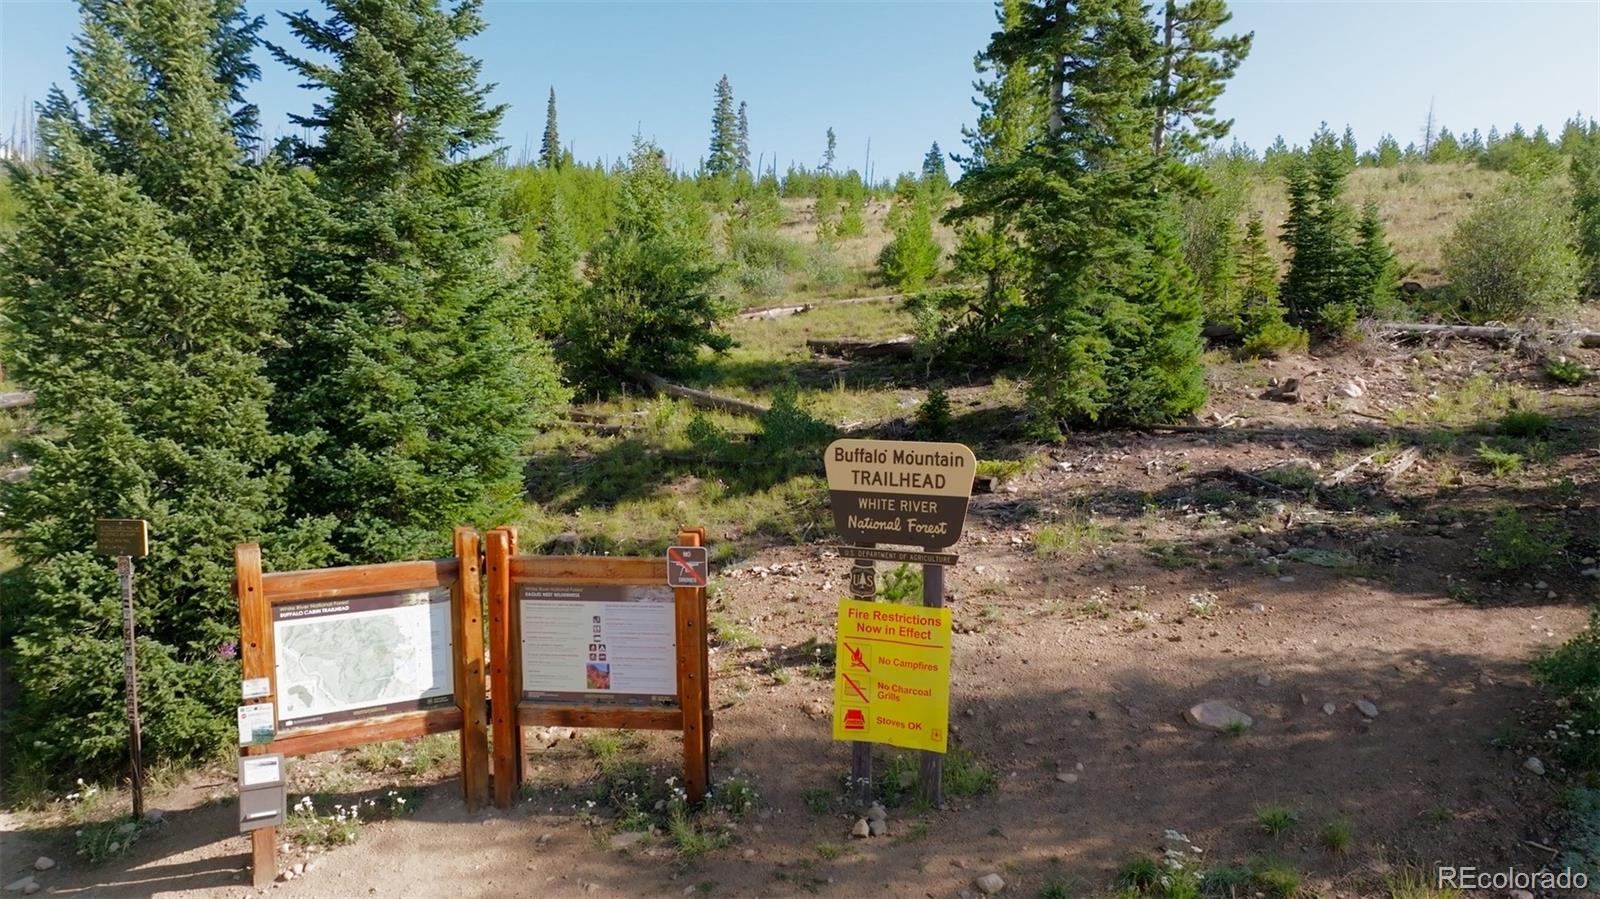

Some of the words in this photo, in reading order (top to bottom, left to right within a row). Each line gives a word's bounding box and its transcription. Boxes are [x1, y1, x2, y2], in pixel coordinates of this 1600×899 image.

[834, 447, 888, 464] Buffalo
[893, 450, 964, 468] Mountain
[851, 470, 946, 489] TRAILHEAD
[858, 497, 896, 511] WHITE
[900, 500, 938, 514] RIVER
[847, 515, 902, 532] National
[907, 518, 948, 535] Forest
[857, 550, 900, 559] DEPARTMENT
[900, 552, 907, 560] OF
[910, 553, 951, 563] AGRICULTURE
[280, 610, 303, 618] BUFFALO
[304, 608, 321, 616] CABIN
[322, 605, 350, 613] TRAILHEAD
[848, 608, 869, 620] Fire
[873, 610, 942, 627] Restrictions
[856, 622, 882, 634] Now
[885, 624, 896, 635] in
[899, 626, 932, 640] Effect
[878, 656, 891, 665] No
[893, 658, 938, 672] Campfires
[877, 682, 889, 691] No
[891, 684, 932, 697] Charcoal
[877, 691, 901, 702] Grills
[876, 716, 905, 728] Stoves
[908, 722, 923, 731] OK
